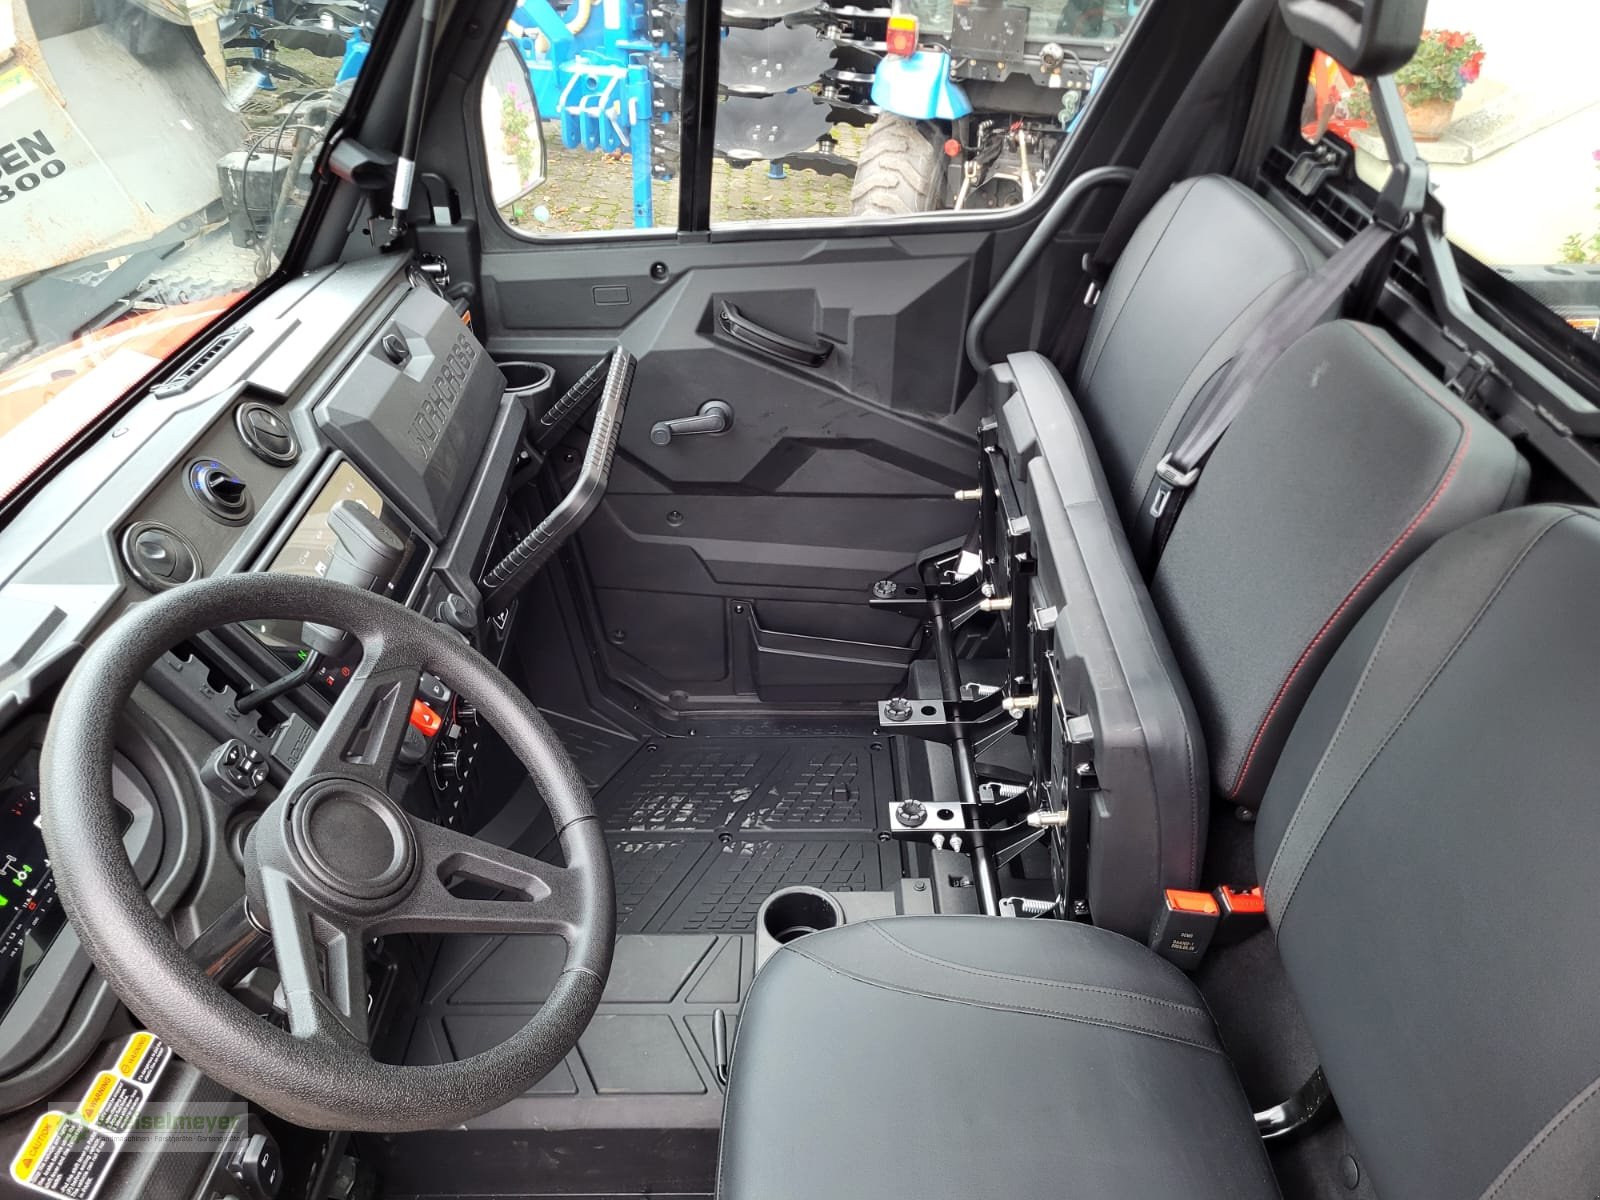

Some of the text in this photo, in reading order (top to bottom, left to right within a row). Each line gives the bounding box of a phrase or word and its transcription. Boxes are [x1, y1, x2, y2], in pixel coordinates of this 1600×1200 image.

[0, 129, 56, 176] EN
[407, 332, 478, 463] WORKCROSS
[88, 1076, 111, 1109] WARNING
[28, 1122, 52, 1157] CAUTION
